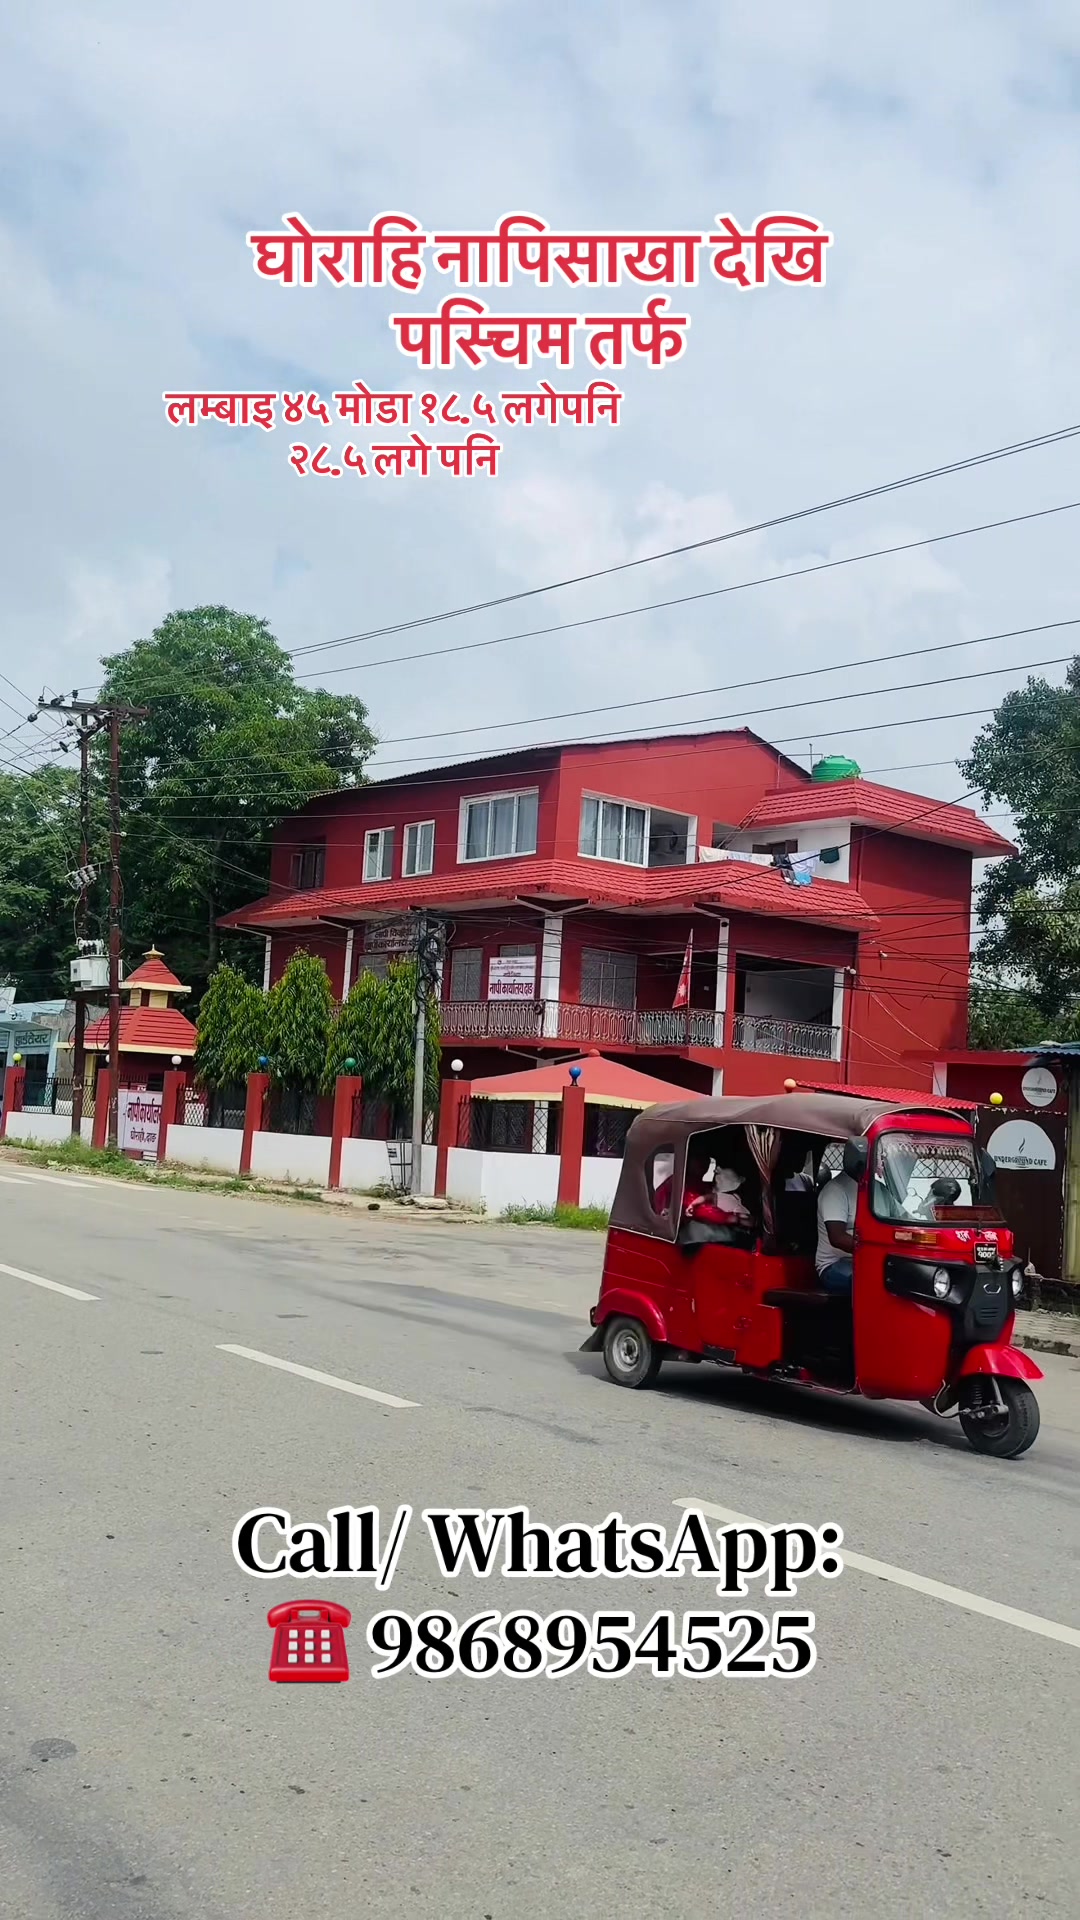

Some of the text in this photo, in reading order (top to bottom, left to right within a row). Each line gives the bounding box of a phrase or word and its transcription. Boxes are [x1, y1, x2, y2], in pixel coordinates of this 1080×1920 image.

[489, 979, 502, 995] नापी
[140, 1097, 162, 1124] कार्याल
[1033, 1158, 1048, 1166] CAFE
